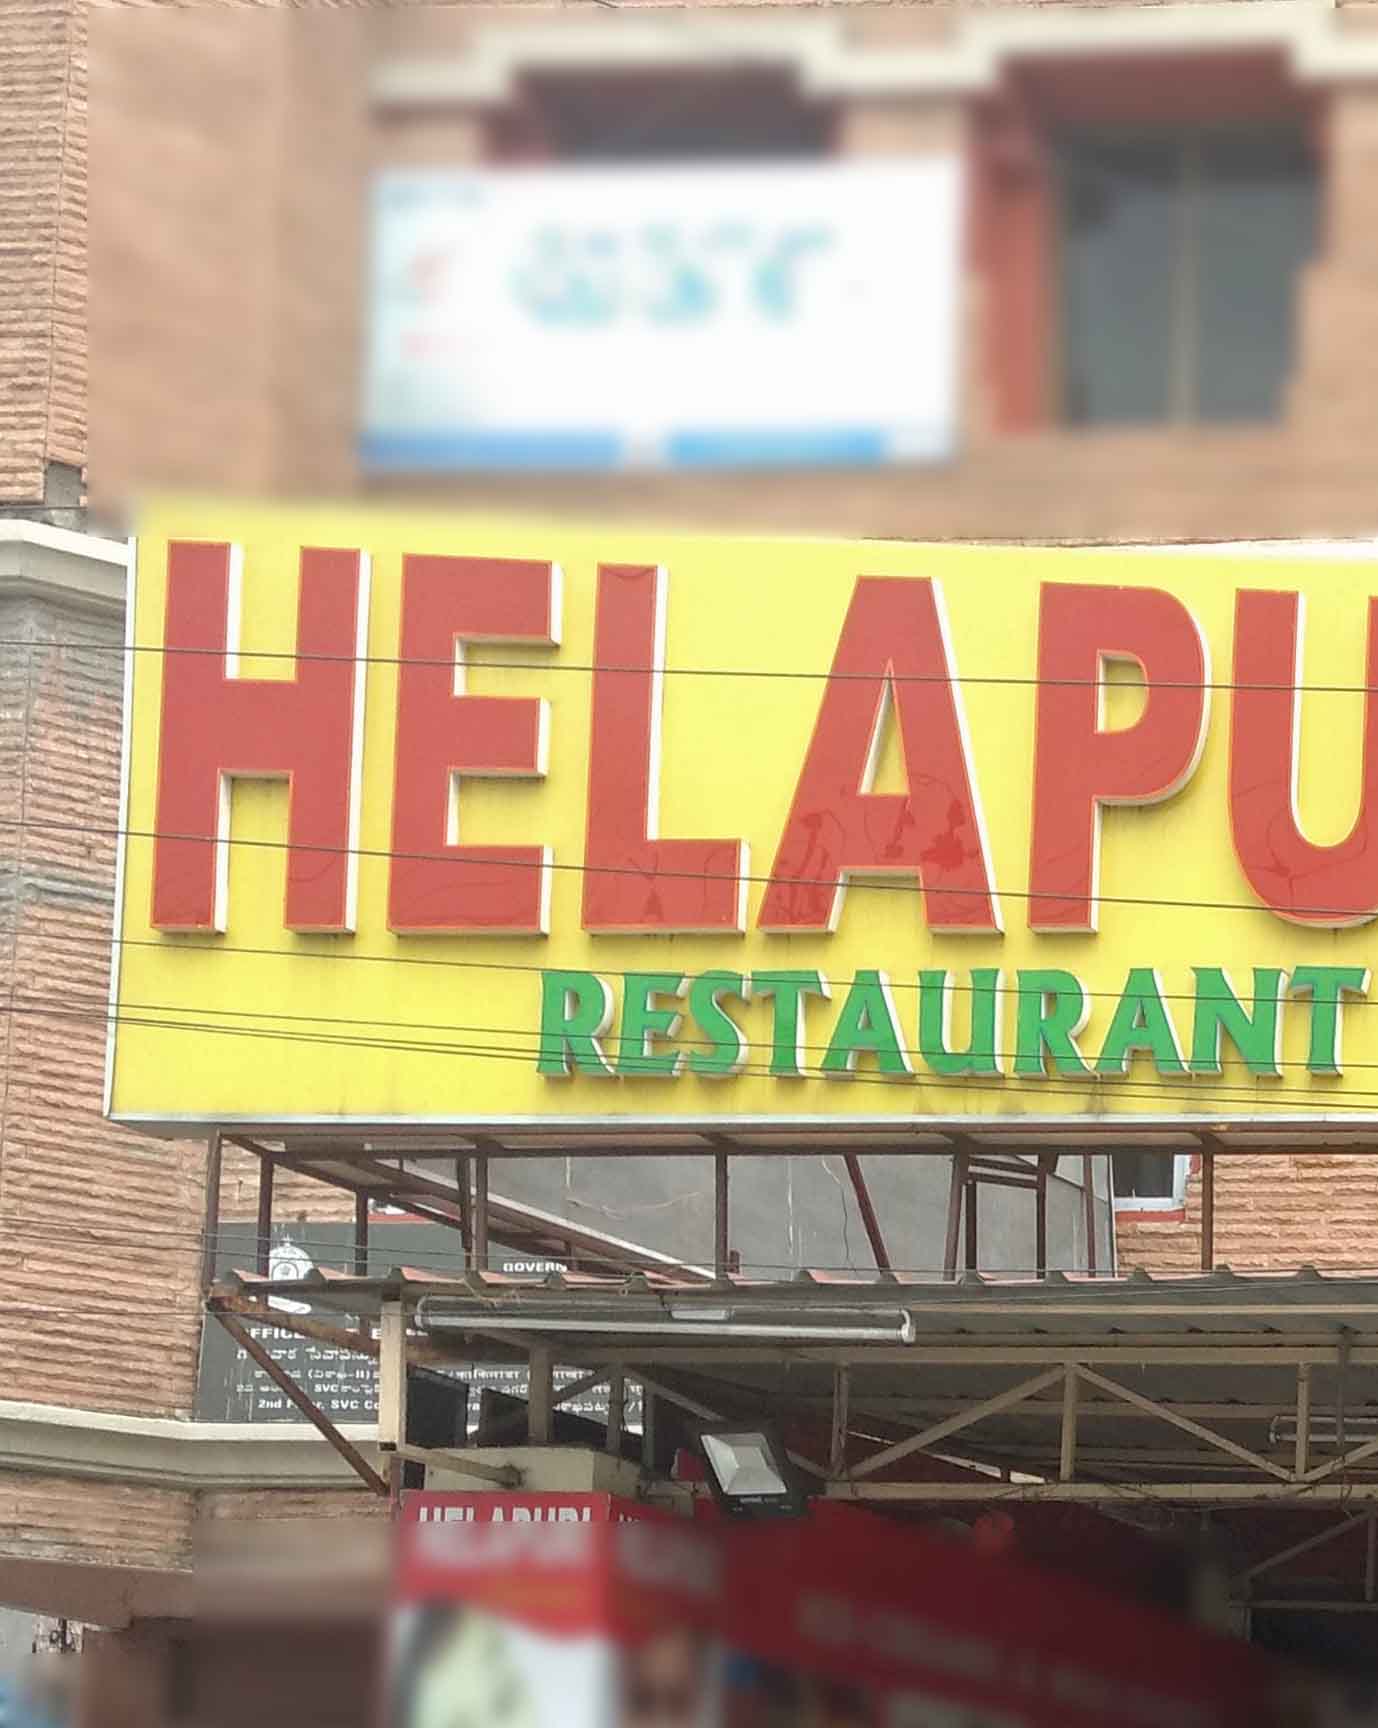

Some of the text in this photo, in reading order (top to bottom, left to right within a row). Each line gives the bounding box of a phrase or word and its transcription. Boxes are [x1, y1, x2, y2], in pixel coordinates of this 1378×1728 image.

[536, 965, 1372, 1079] RESTAURANT
[247, 1327, 306, 1340] FFIC
[257, 1399, 283, 1409] 2nd
[330, 1399, 360, 1410] SVC
